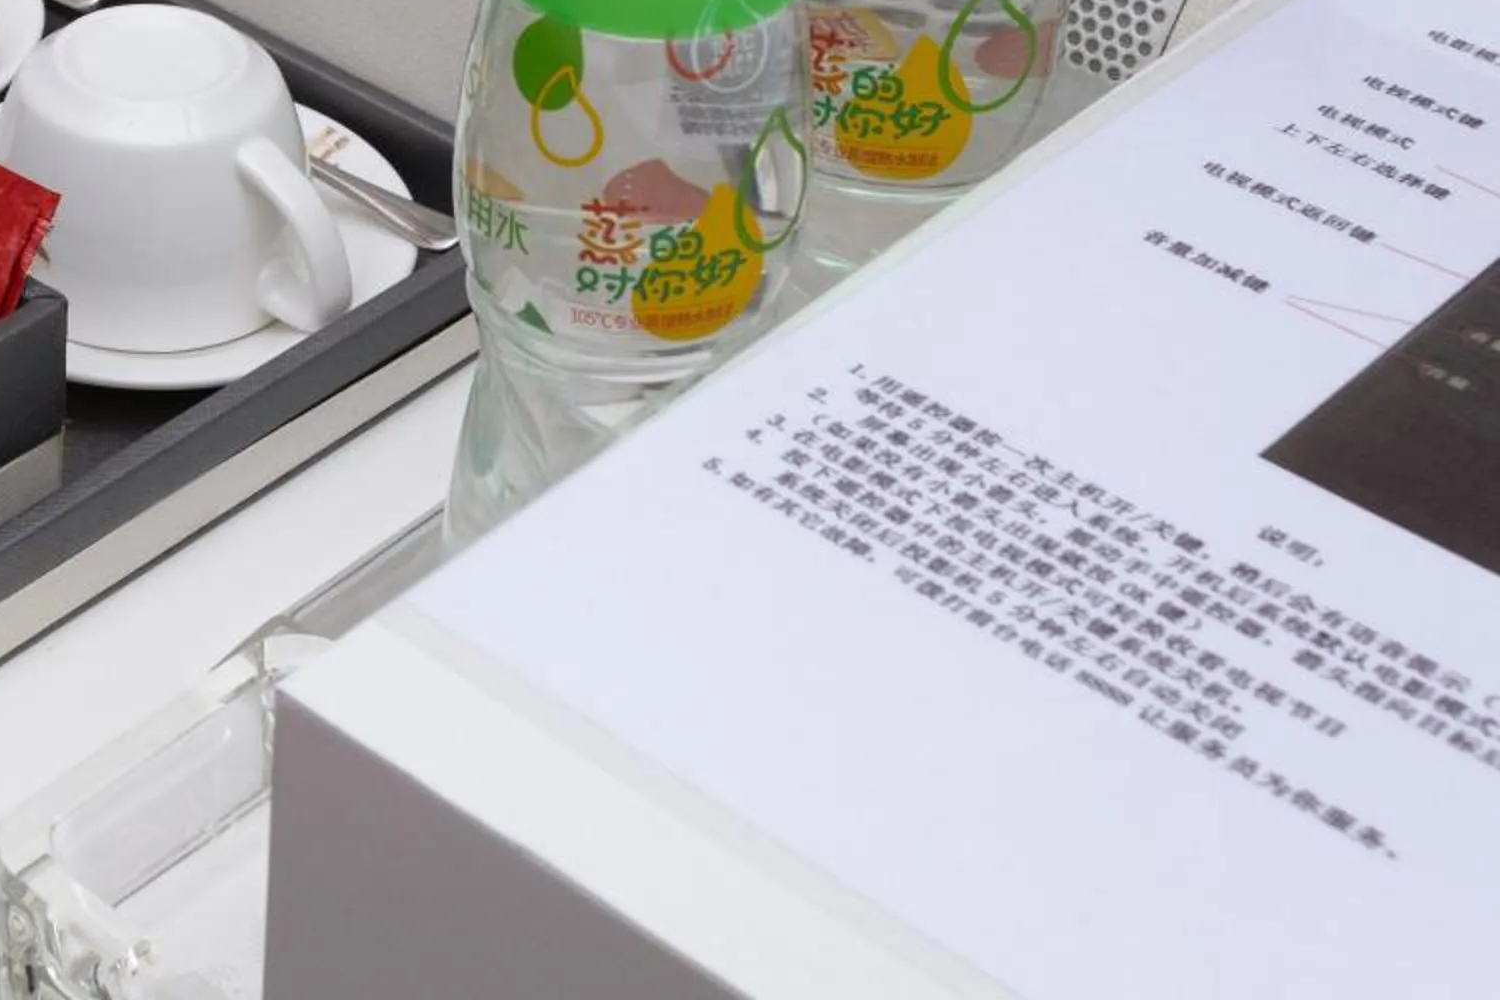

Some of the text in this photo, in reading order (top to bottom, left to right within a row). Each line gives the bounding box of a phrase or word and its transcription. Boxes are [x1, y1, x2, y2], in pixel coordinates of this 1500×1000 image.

[1428, 30, 1500, 66] 电影模
[1317, 105, 1415, 150] 电视模式
[1363, 76, 1486, 129] 电视模式键
[1279, 123, 1451, 201] 上下左右选择键
[1204, 162, 1378, 245] 电视模式返回键
[577, 248, 748, 304] 对你好
[1143, 230, 1271, 294] 音量加减键
